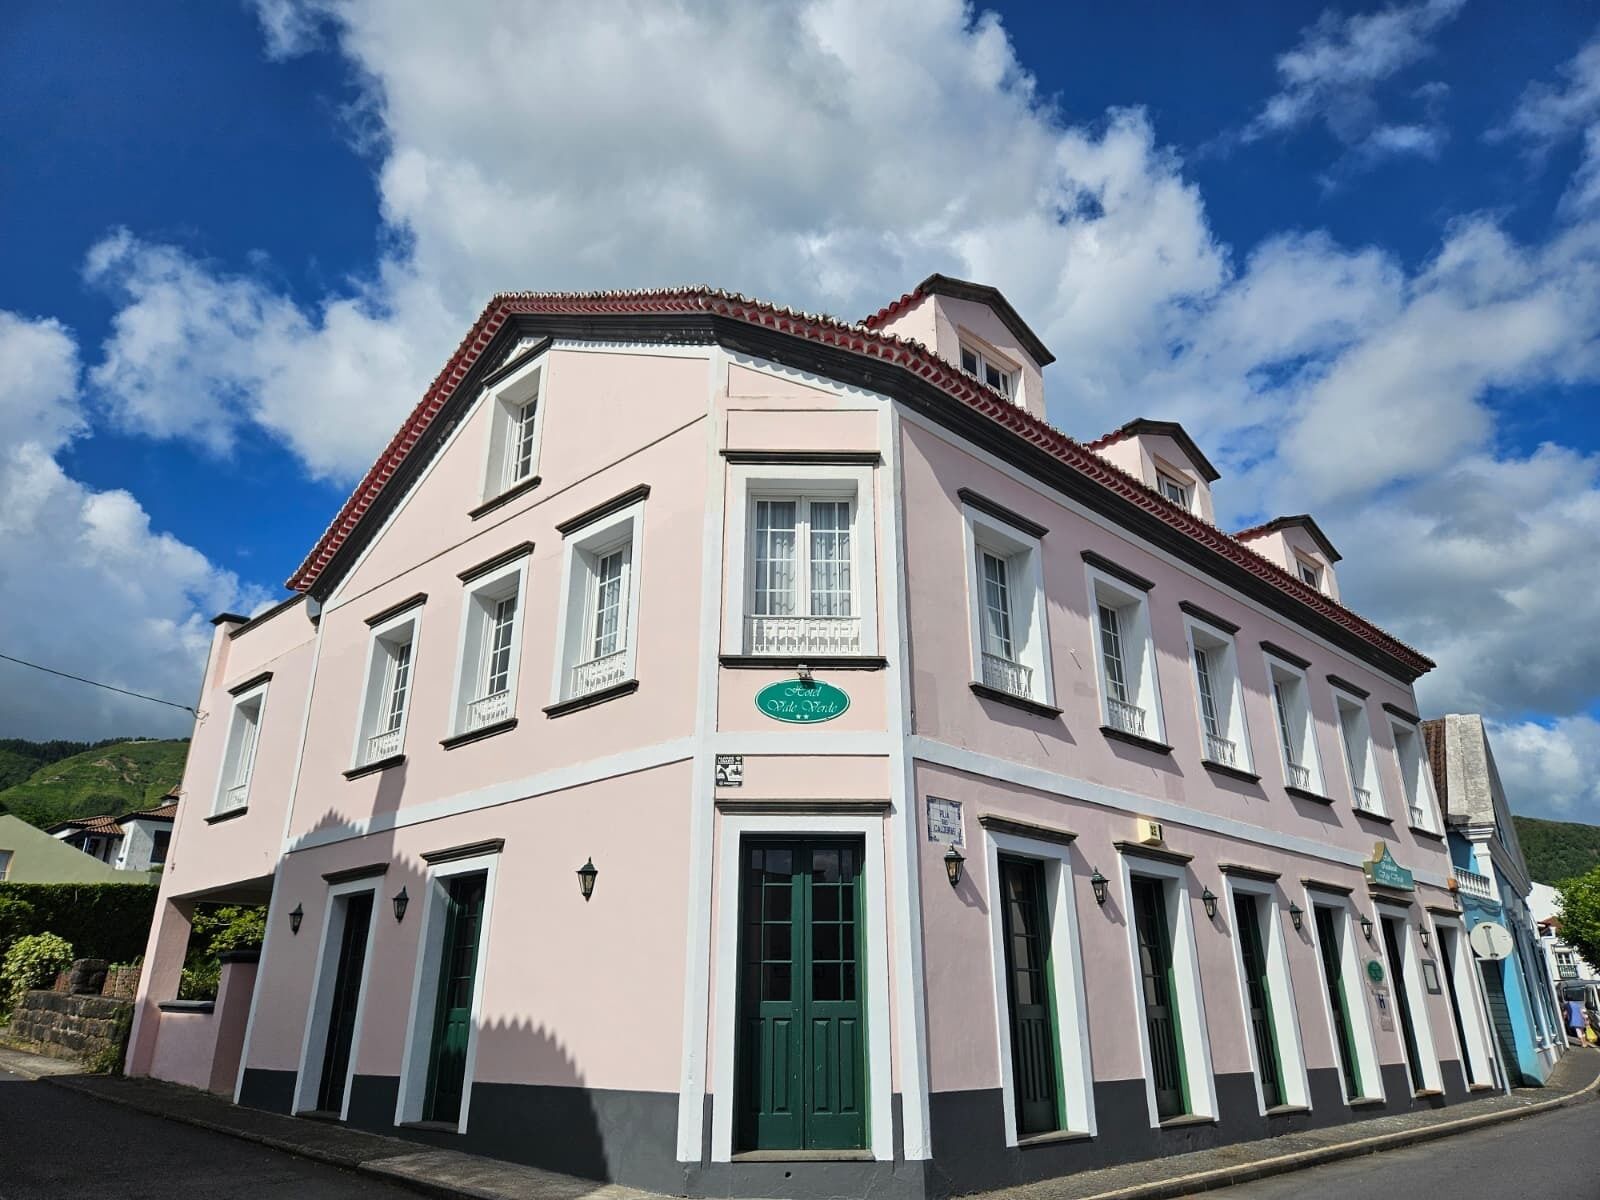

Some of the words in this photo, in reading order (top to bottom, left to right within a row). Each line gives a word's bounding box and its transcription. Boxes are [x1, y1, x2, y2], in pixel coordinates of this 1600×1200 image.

[785, 684, 822, 696] Hotel
[767, 699, 797, 712] Vale
[801, 699, 838, 712] Verde
